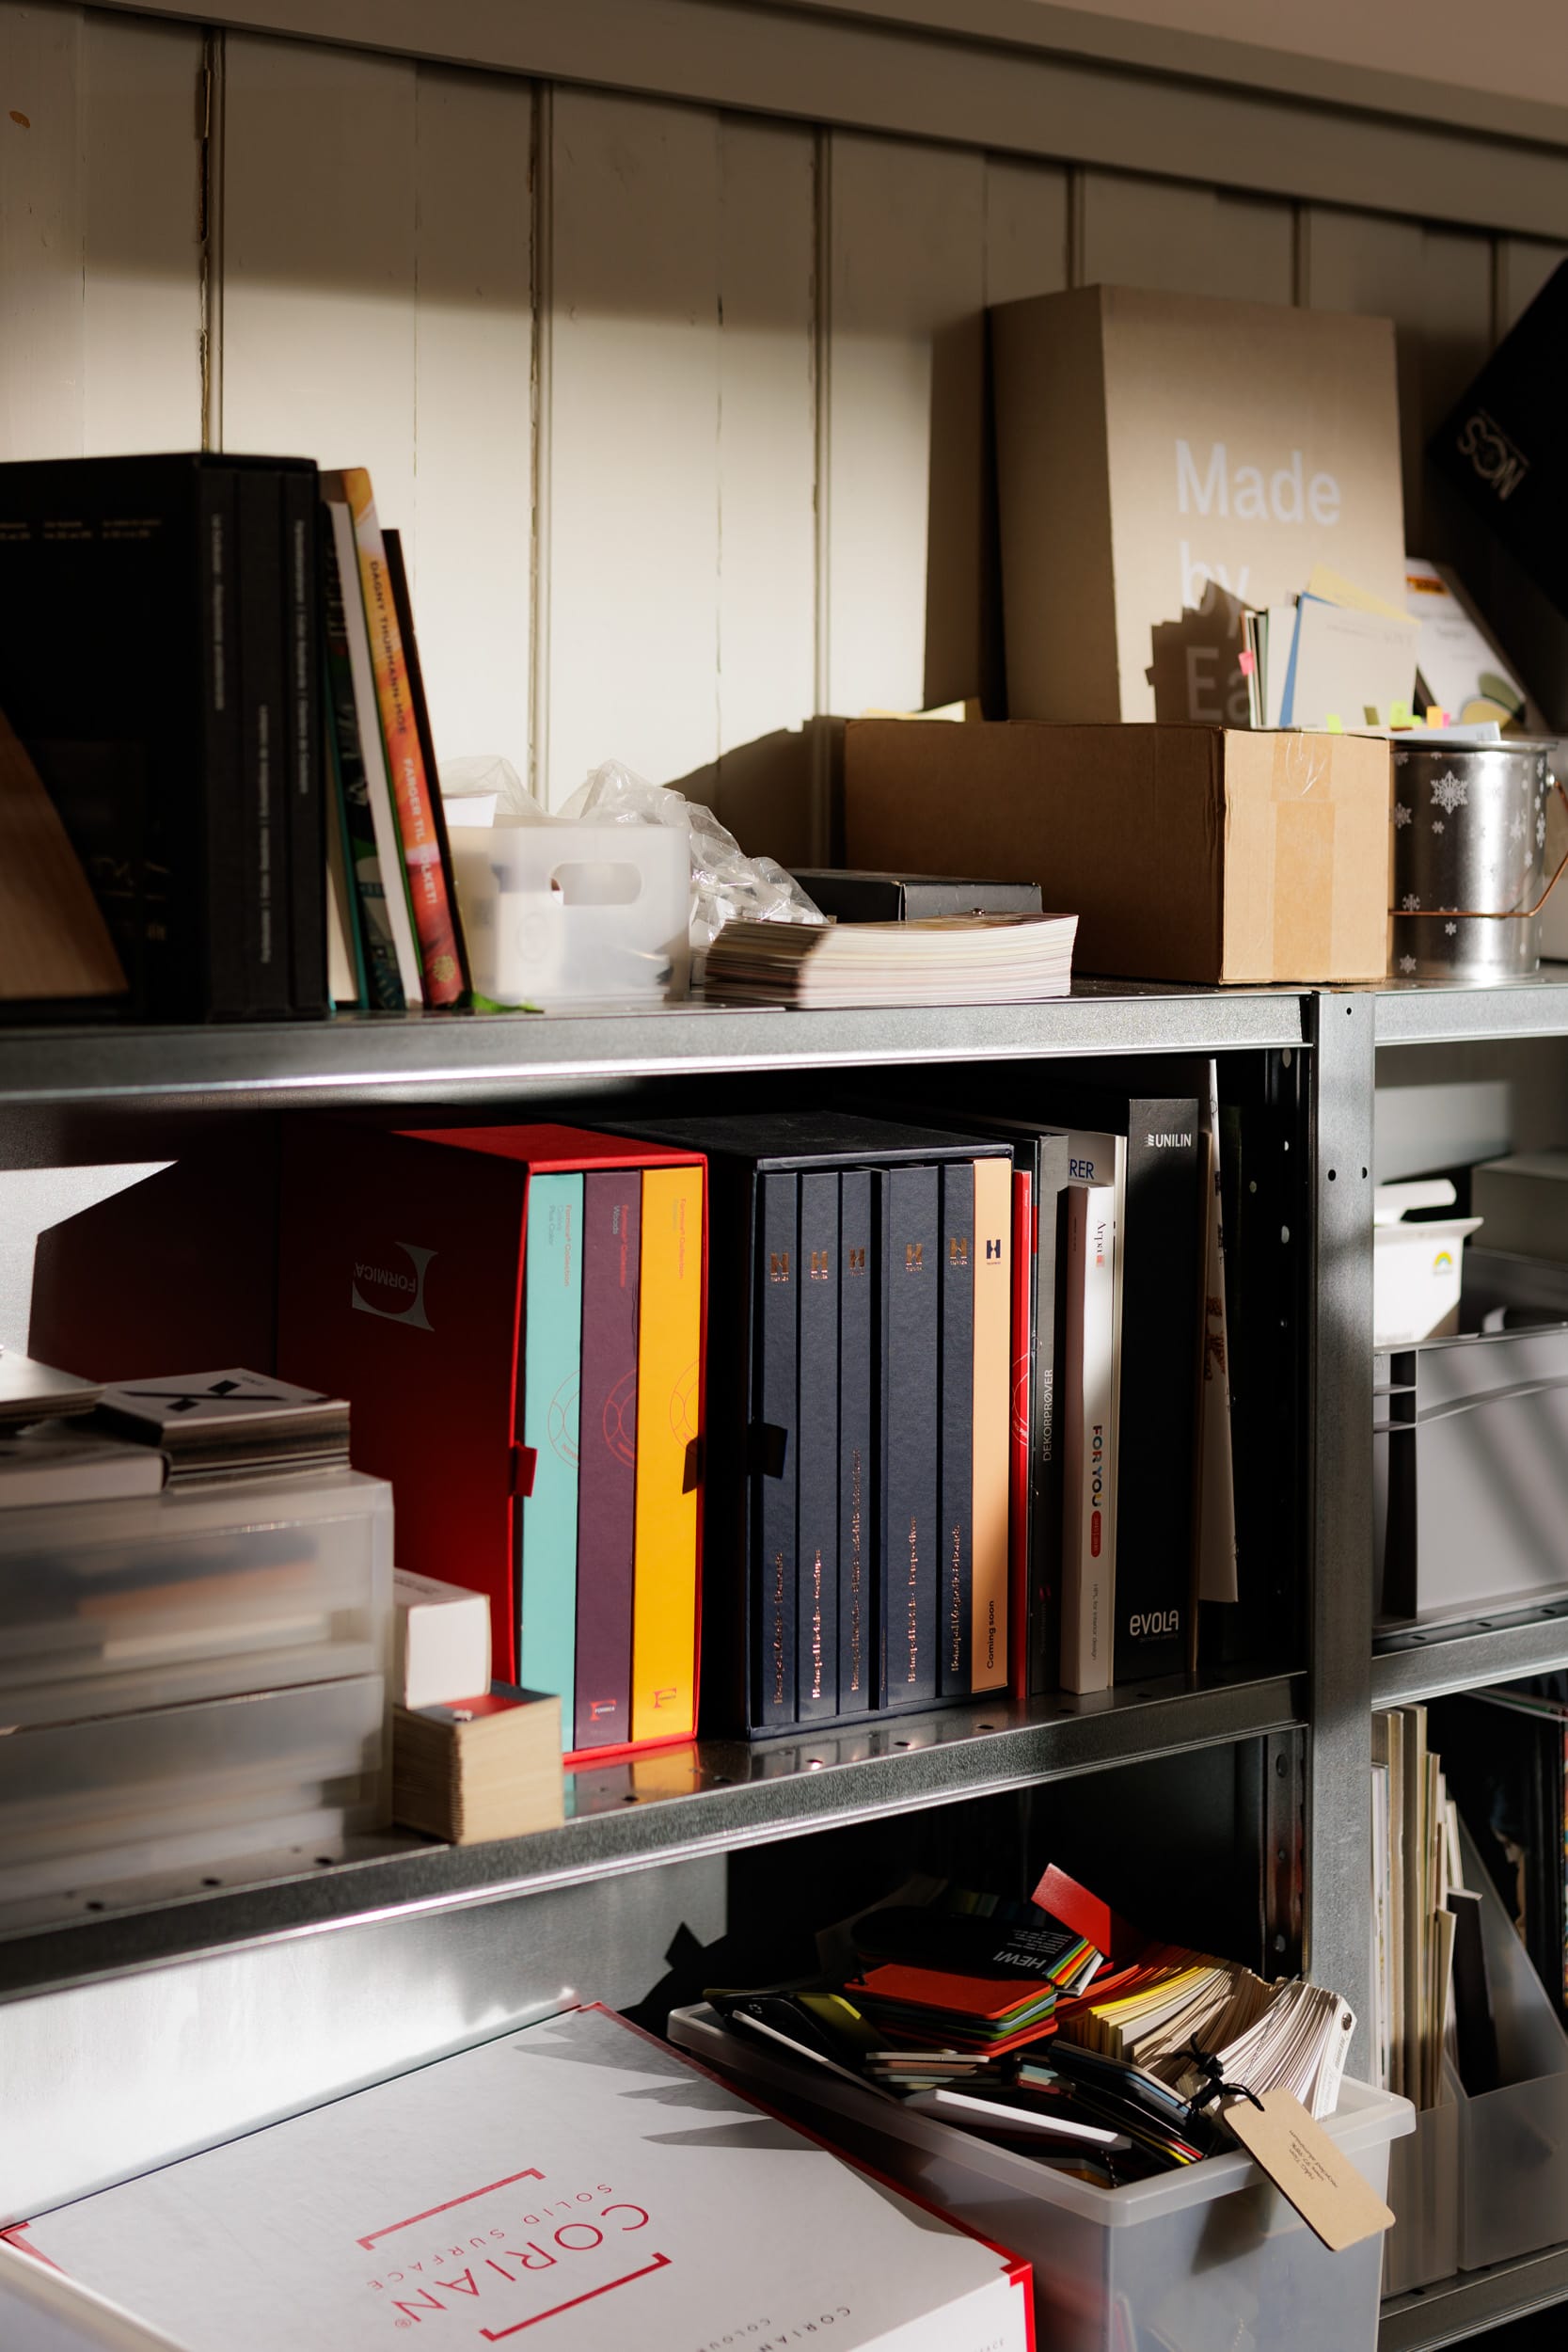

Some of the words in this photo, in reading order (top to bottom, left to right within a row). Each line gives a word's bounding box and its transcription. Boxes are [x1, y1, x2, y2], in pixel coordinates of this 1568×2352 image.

[1176, 438, 1340, 525] Made
[371, 561, 386, 610] DAGNY
[1180, 540, 1249, 639] by
[404, 758, 420, 816] FARGER
[414, 818, 425, 843] TIL
[1155, 1134, 1192, 1148] UNILIN
[1069, 1158, 1095, 1180] RER
[612, 1204, 621, 1235] Woods
[354, 1262, 417, 1295] FORMICA
[1043, 1369, 1053, 1461] DEKORPRØVER
[1092, 1424, 1102, 1464] FOR
[1091, 1465, 1102, 1507] YOU
[987, 1627, 996, 1669] Coming
[992, 1951, 1047, 1969] HEWI
[522, 2184, 612, 2225] SOLID
[367, 2229, 504, 2291] SURFACE
[696, 2318, 770, 2352] COLOU
[758, 2306, 851, 2352] CORIAN
